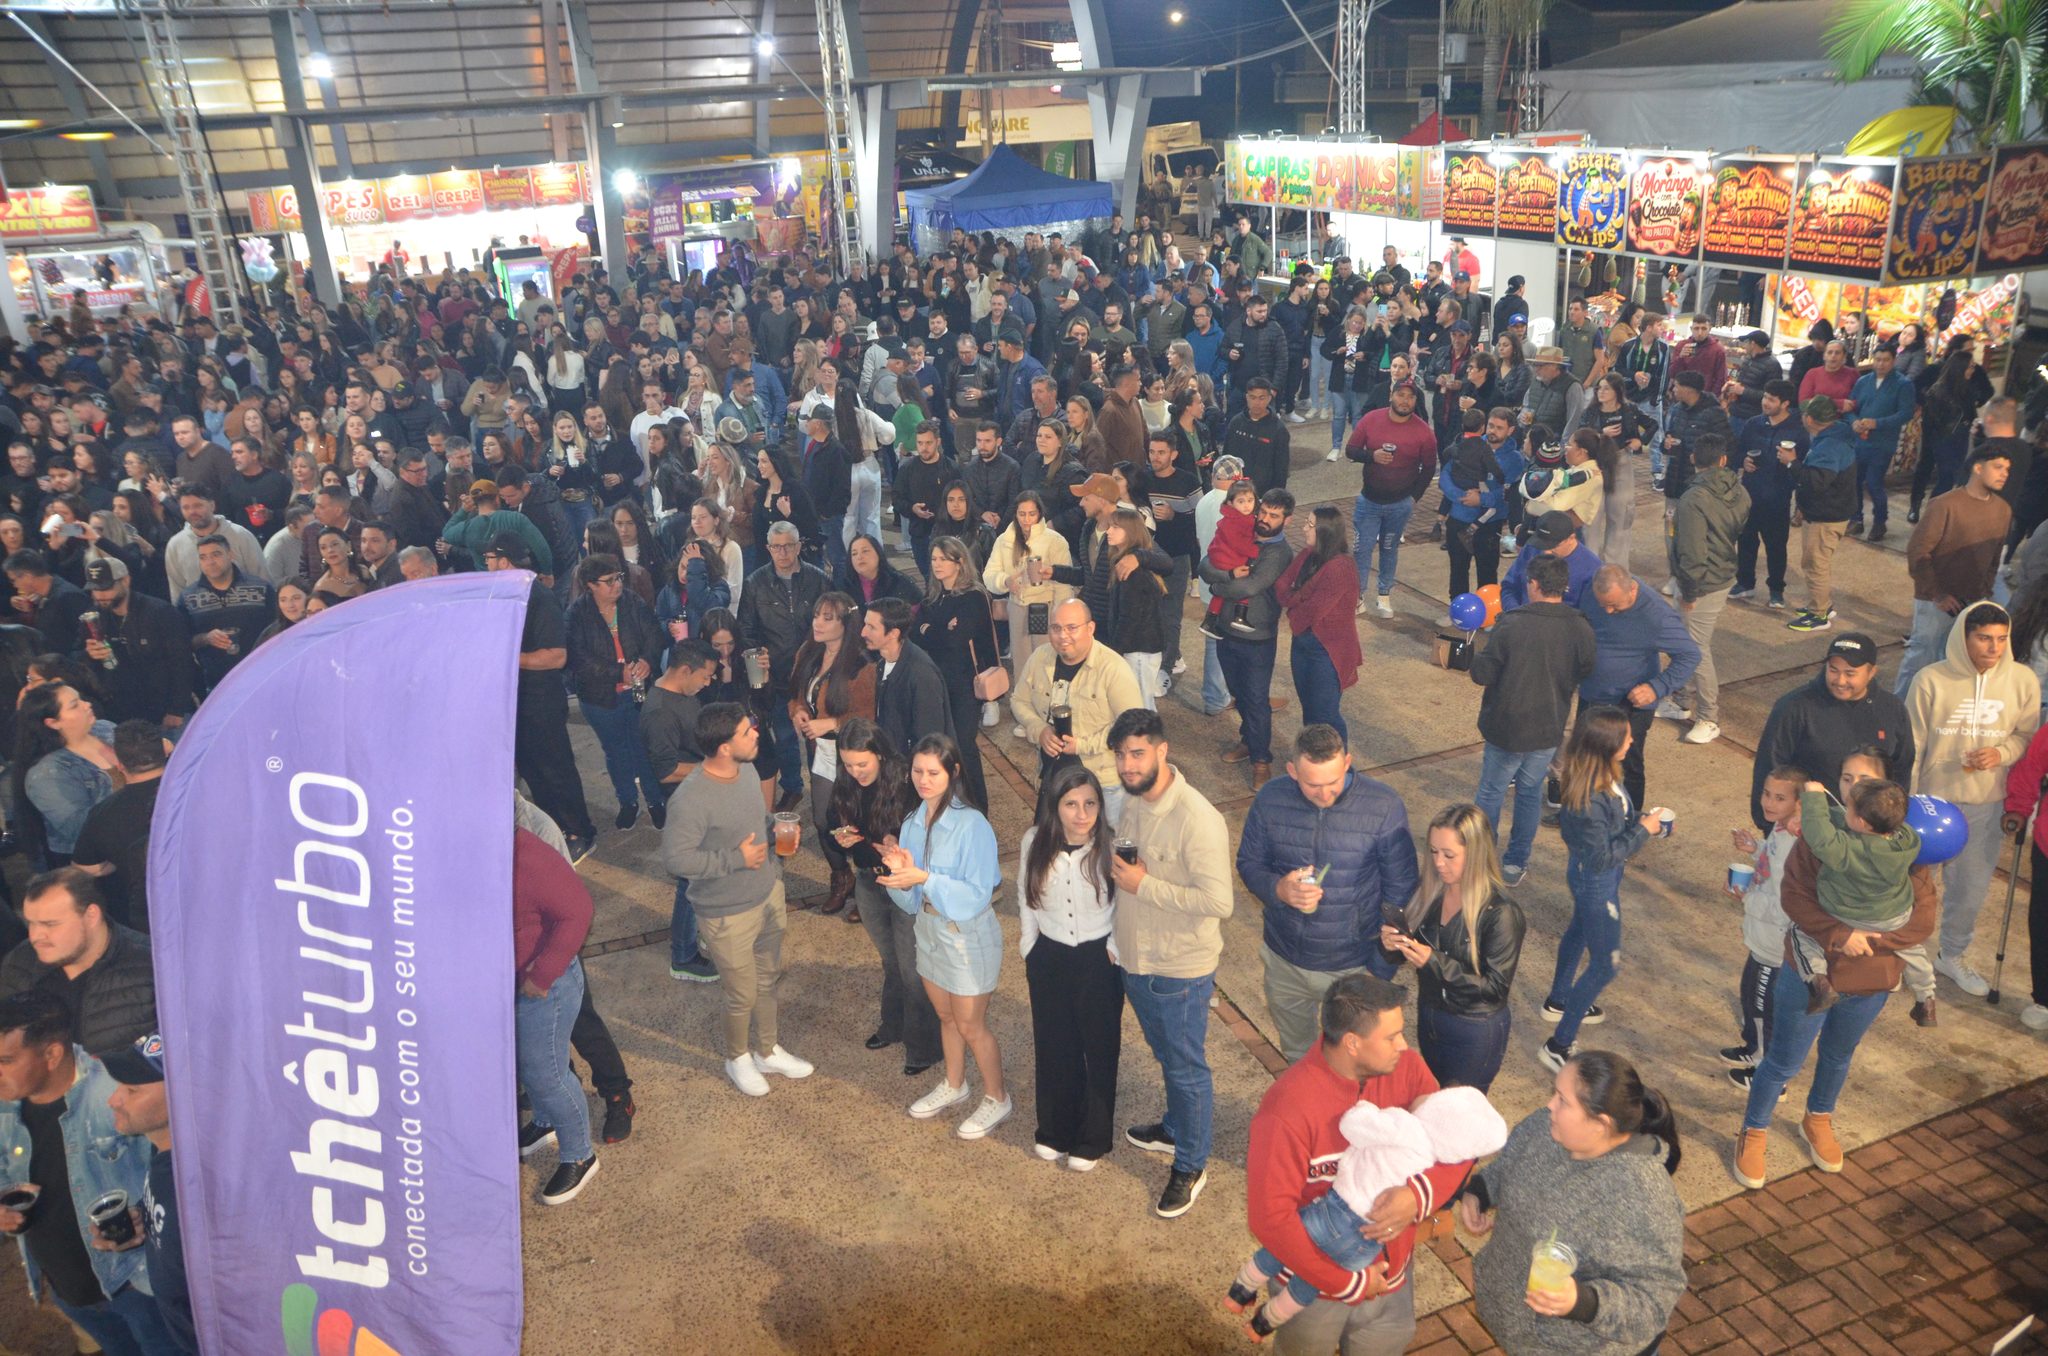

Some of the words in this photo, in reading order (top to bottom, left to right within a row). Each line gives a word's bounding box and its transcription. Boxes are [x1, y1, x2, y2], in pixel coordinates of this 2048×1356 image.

[912, 167, 951, 176] UNSA
[1245, 155, 1310, 181] CAIPIRAS
[1316, 154, 1396, 192] DRINKS
[1568, 152, 1622, 173] Batata
[1906, 159, 1981, 191] Batata
[1461, 173, 1495, 195] ESPETINHO
[1519, 175, 1557, 197] ESPETINHO
[1639, 172, 1693, 202] Morango
[389, 194, 421, 210] REI
[435, 190, 481, 204] CREPE
[1643, 198, 1685, 223] Chocolate
[1736, 187, 1789, 216] ESPETINHO
[1827, 192, 1889, 223] ESPETINHO
[0, 215, 92, 232] NTREVERO
[1935, 727, 1959, 736] new
[384, 799, 415, 927] mundo.
[394, 938, 417, 998] seu
[273, 771, 390, 1288] tchêturbo
[396, 1008, 417, 1028] o
[397, 1039, 421, 1106] com
[394, 1117, 428, 1277] conectada
